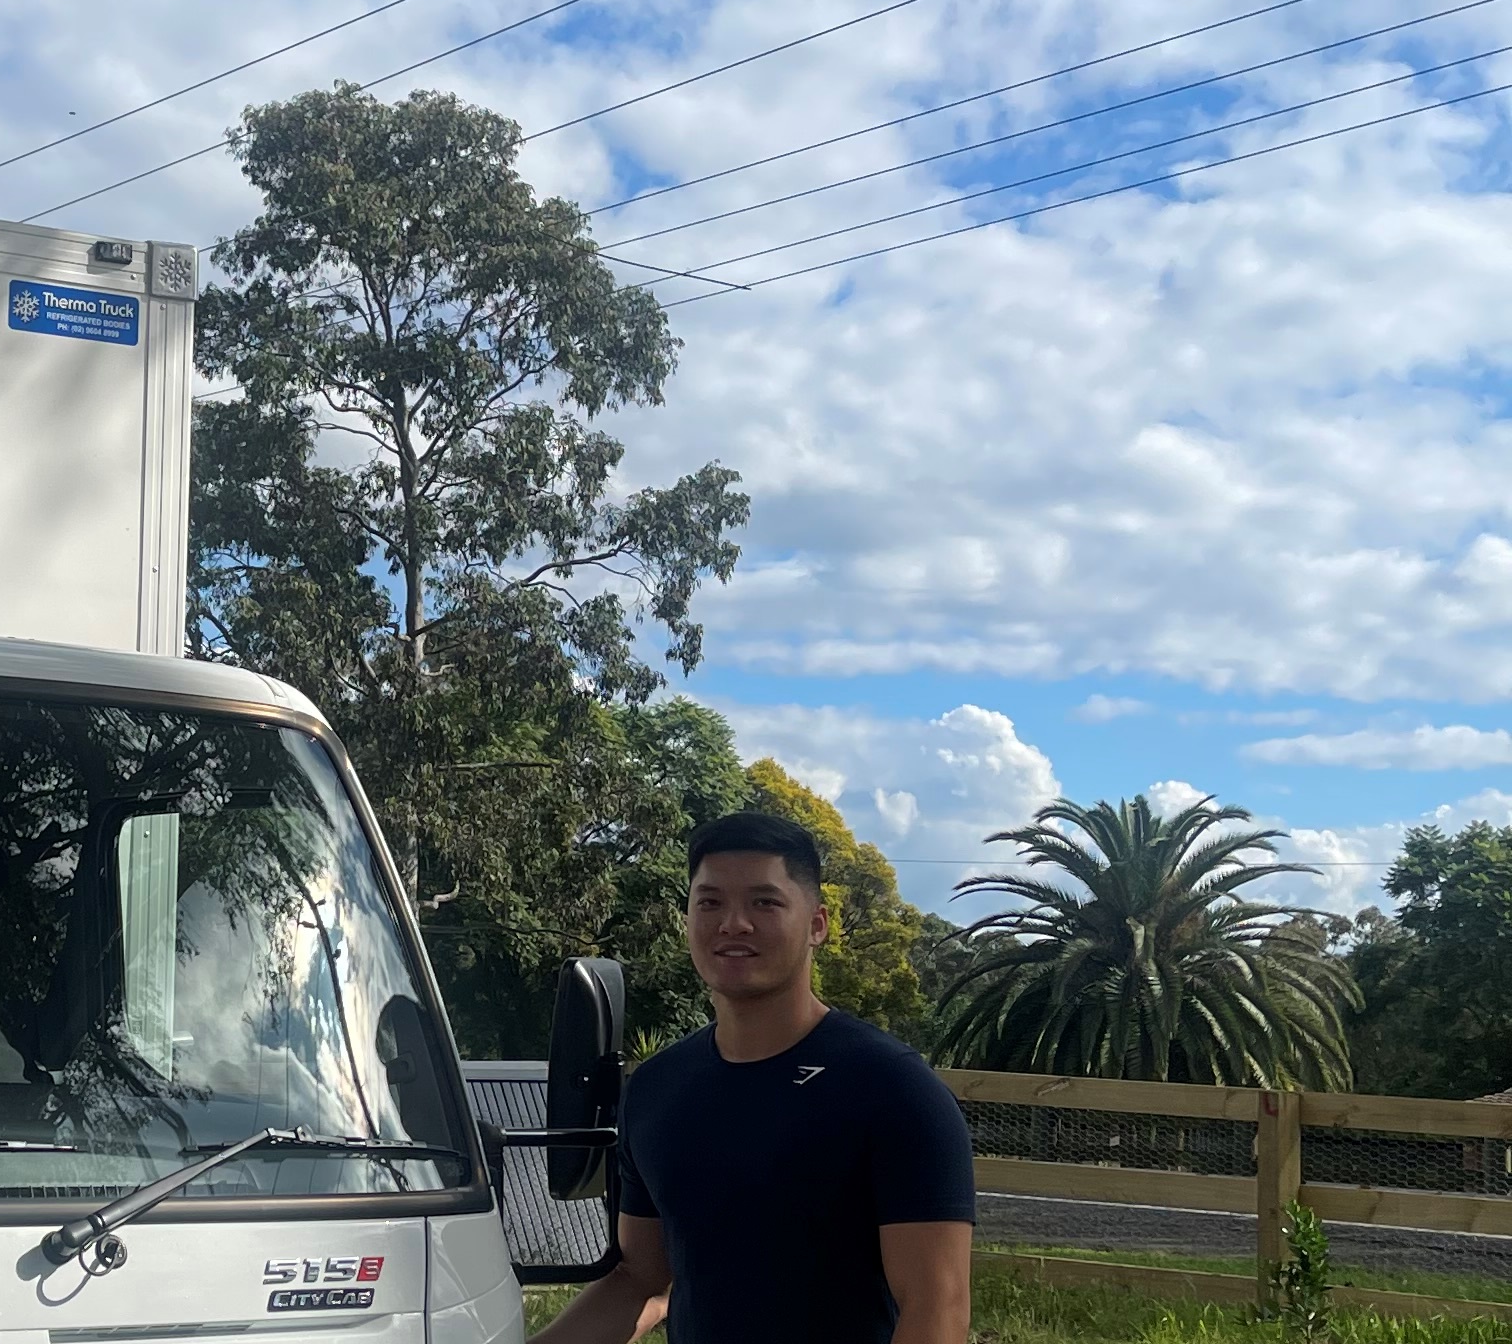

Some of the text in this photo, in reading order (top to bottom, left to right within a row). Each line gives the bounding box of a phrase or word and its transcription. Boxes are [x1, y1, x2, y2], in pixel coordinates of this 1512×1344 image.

[42, 291, 134, 318] Therma Truck
[46, 311, 131, 330] REFRIGERATED BODIES
